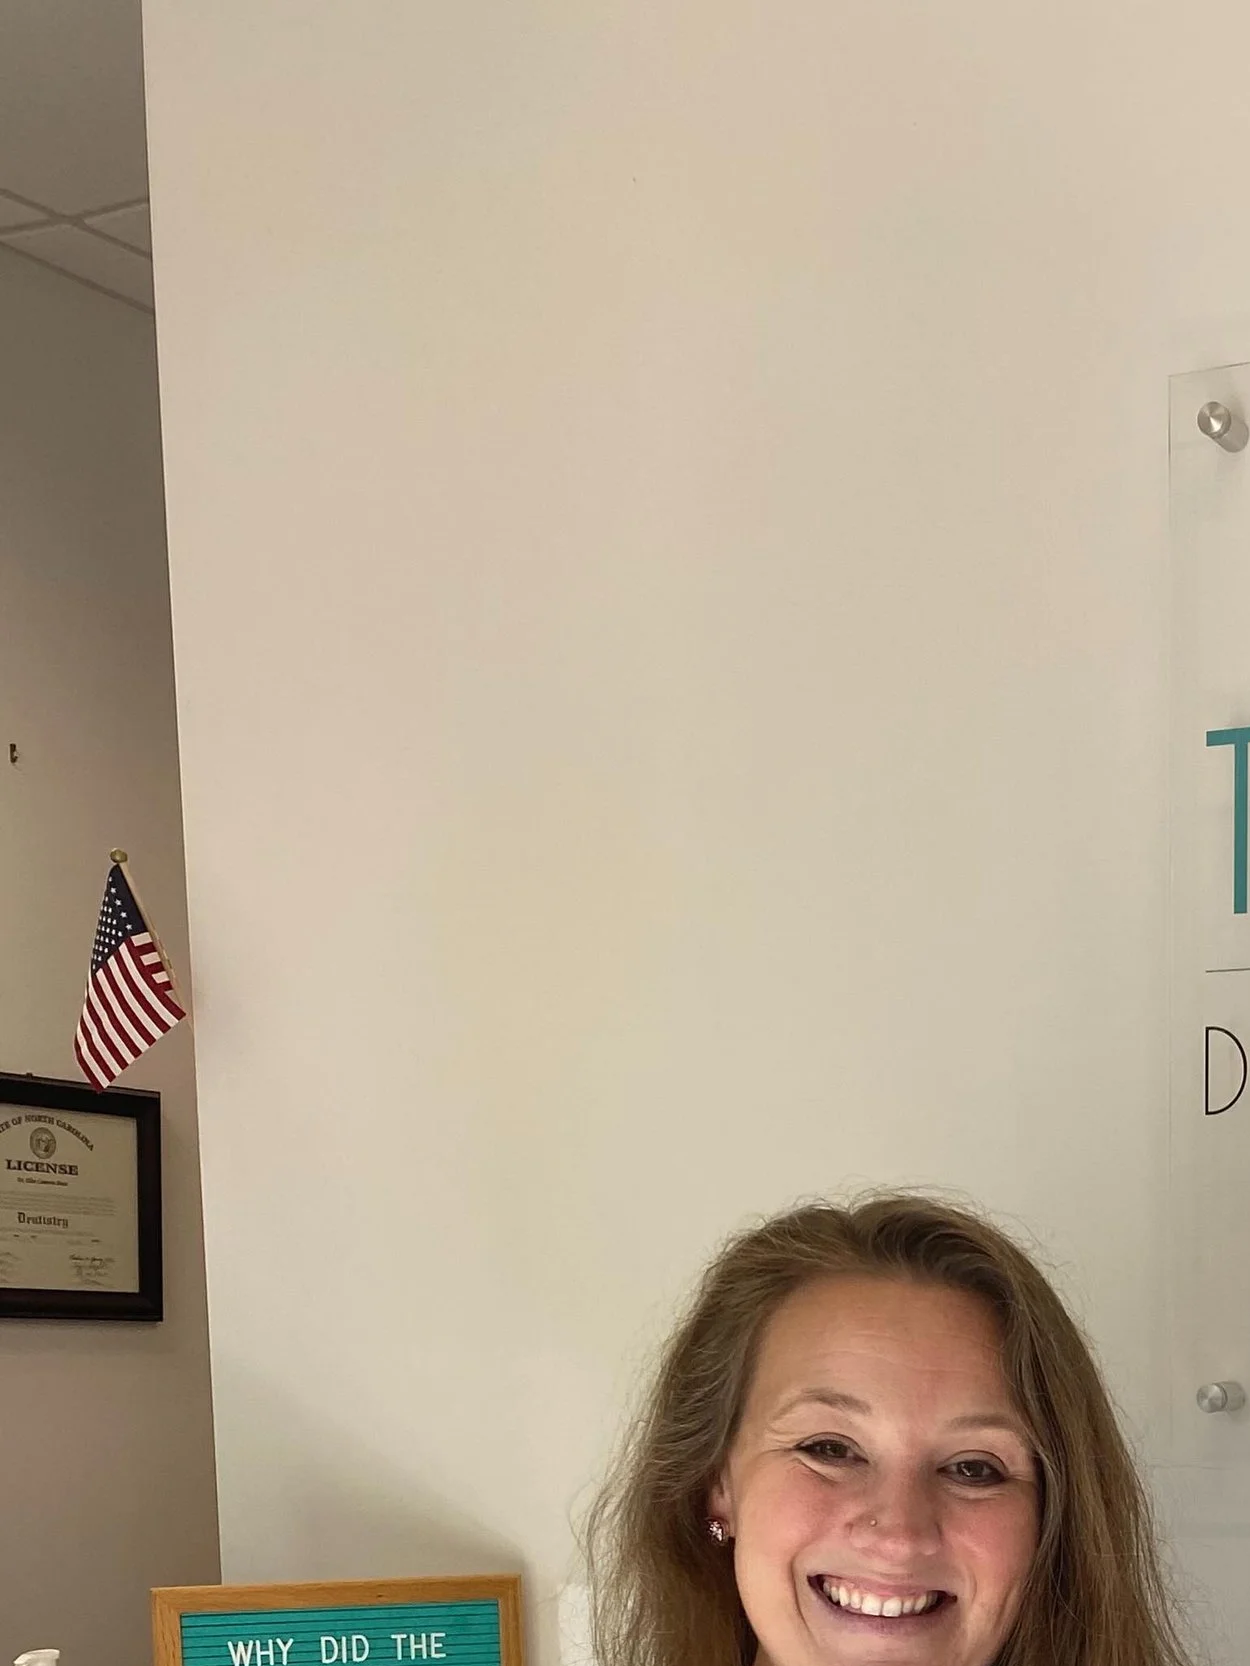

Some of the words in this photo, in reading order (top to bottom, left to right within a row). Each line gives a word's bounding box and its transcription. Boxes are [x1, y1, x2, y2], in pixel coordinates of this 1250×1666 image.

[6, 1159, 78, 1175] LICENSE
[320, 1634, 370, 1664] DID
[391, 1632, 446, 1660] THE
